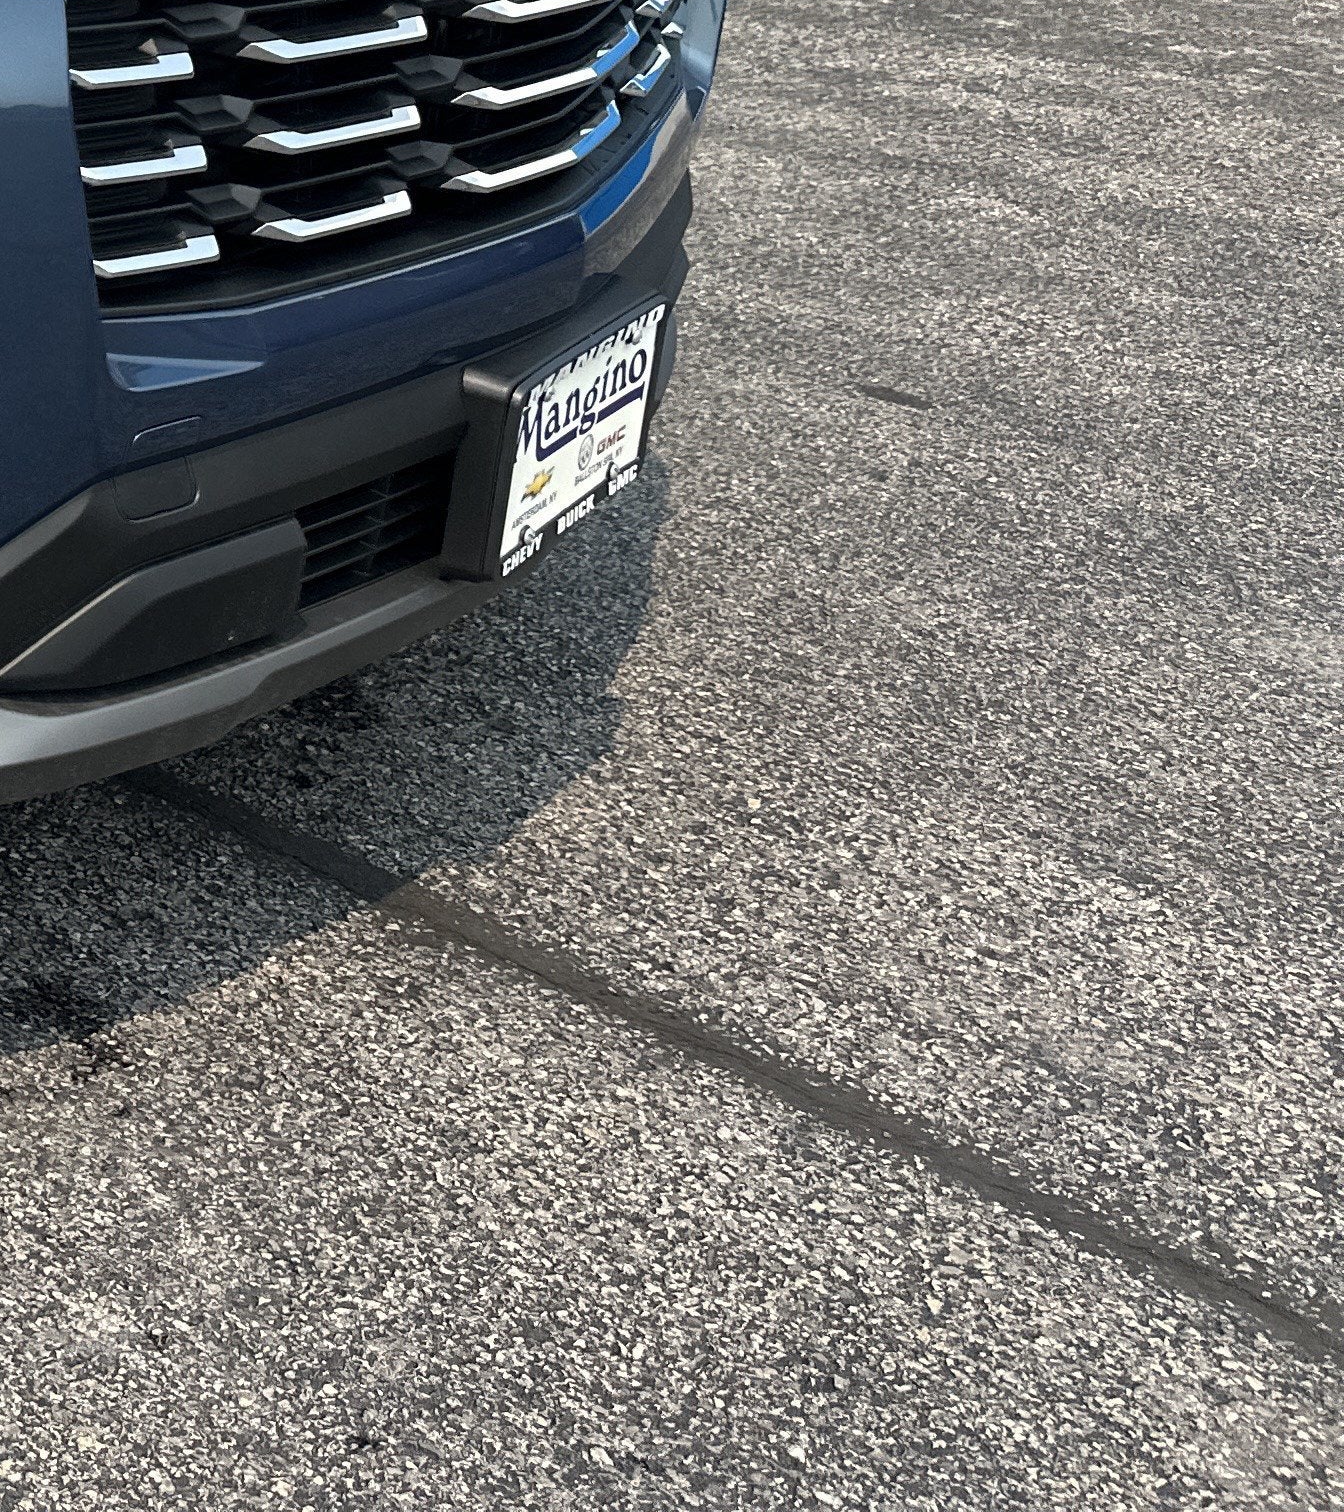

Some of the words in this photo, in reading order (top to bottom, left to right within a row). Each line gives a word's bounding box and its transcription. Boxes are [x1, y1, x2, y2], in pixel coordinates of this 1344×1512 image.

[522, 348, 648, 456] Mangino
[597, 425, 626, 455] GMC
[502, 533, 543, 577] CHEVY
[557, 493, 596, 535] BUICK
[608, 464, 639, 496] GMC
